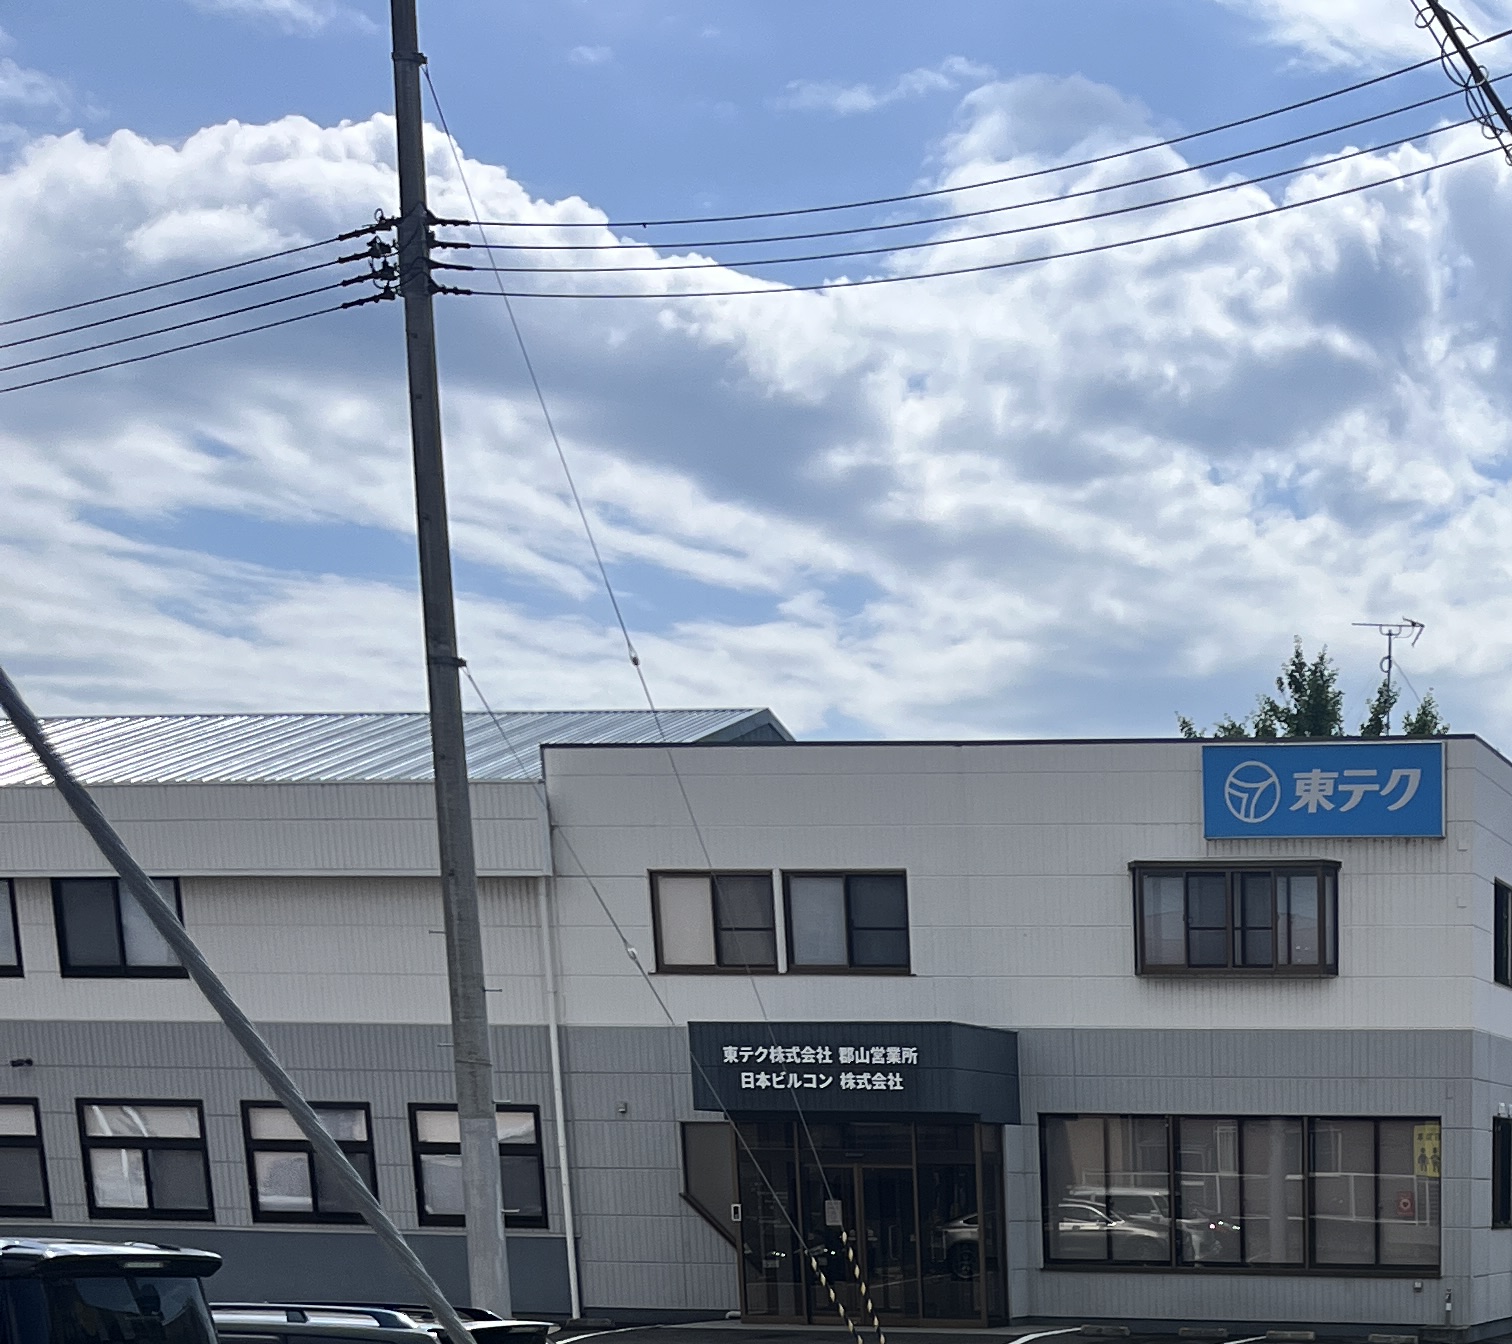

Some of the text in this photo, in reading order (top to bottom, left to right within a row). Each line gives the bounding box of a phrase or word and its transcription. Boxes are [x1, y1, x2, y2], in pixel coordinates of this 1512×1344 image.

[1289, 768, 1421, 813] 東テク
[722, 1046, 918, 1065] 東テク株式会社 郡山営業所
[741, 1072, 904, 1090] 日本ビルコン 株式会社
